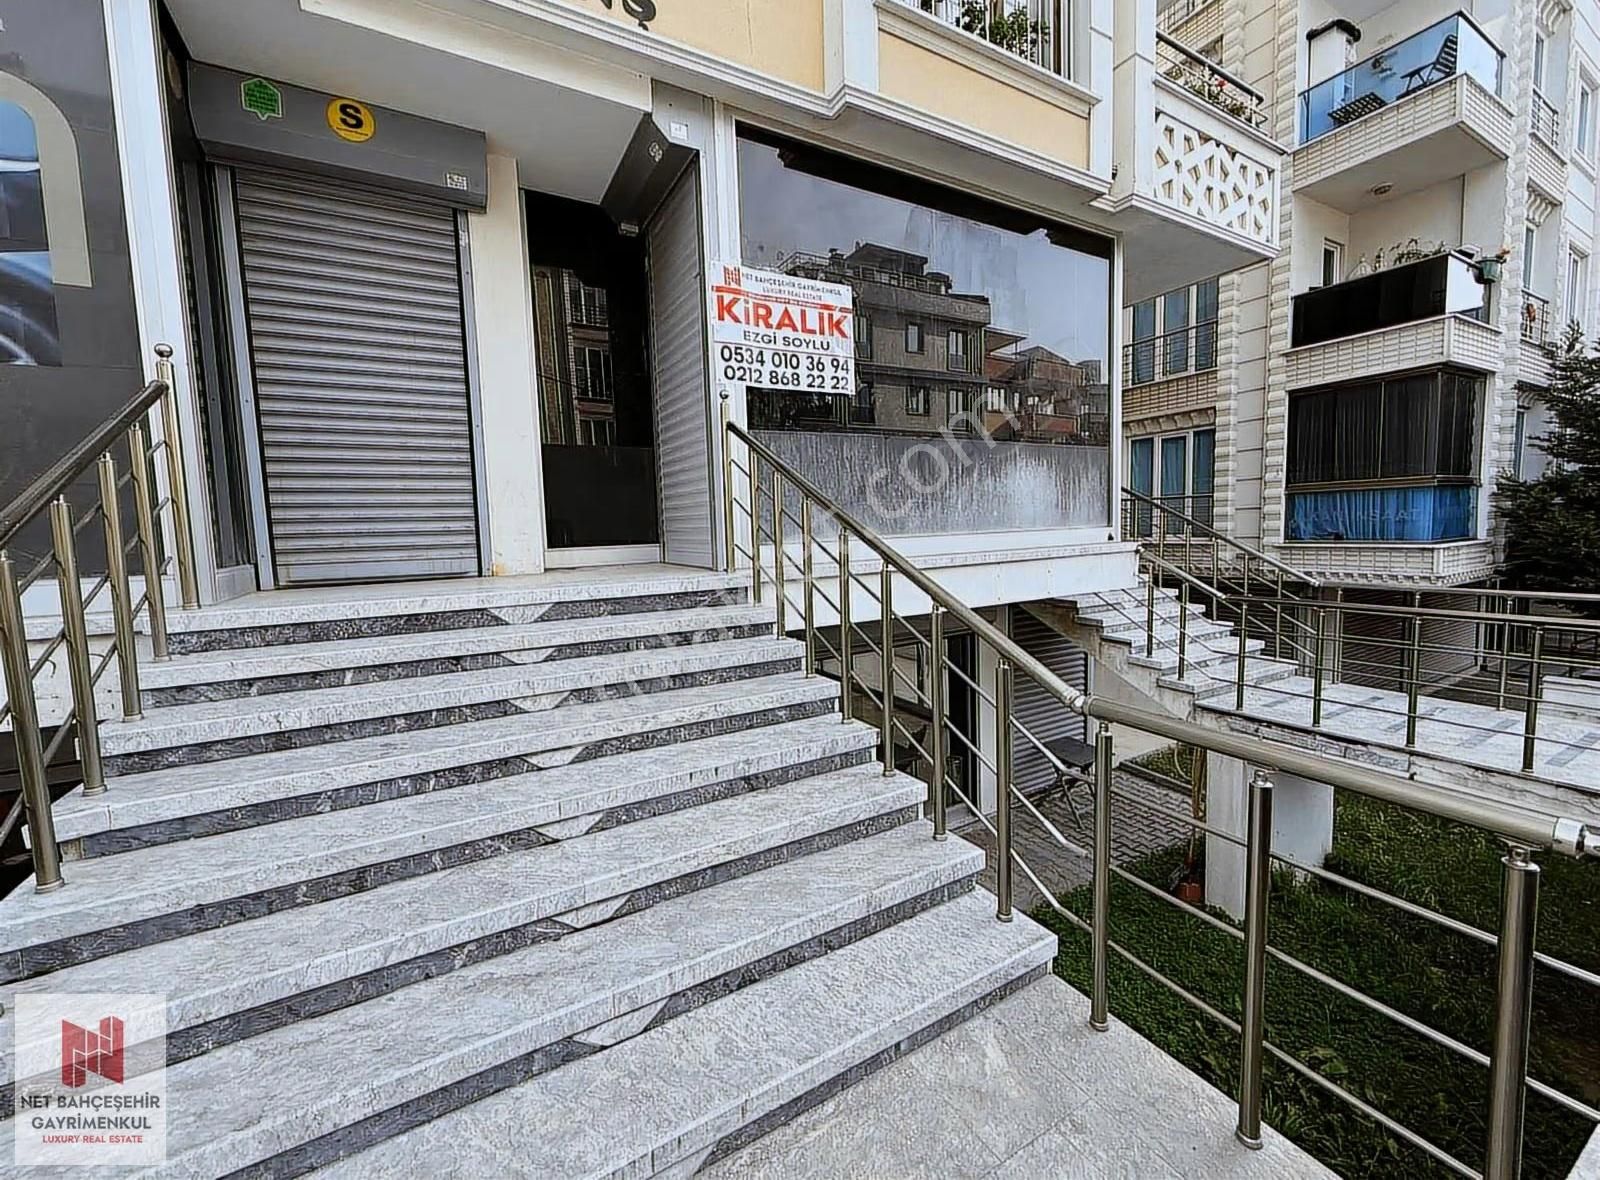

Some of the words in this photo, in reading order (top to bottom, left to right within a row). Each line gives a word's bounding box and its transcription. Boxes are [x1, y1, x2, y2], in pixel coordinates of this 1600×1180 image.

[339, 103, 363, 129] S
[717, 294, 849, 339] KİRALIK
[743, 330, 777, 345] EZGİ
[782, 336, 831, 351] SOYLU
[721, 345, 766, 367] 0534
[771, 352, 800, 370] 010
[806, 355, 825, 373] 36
[831, 358, 849, 375] 94
[724, 365, 763, 384] 0212
[769, 370, 801, 387] 868
[806, 373, 825, 389] 22
[831, 376, 849, 391] 22
